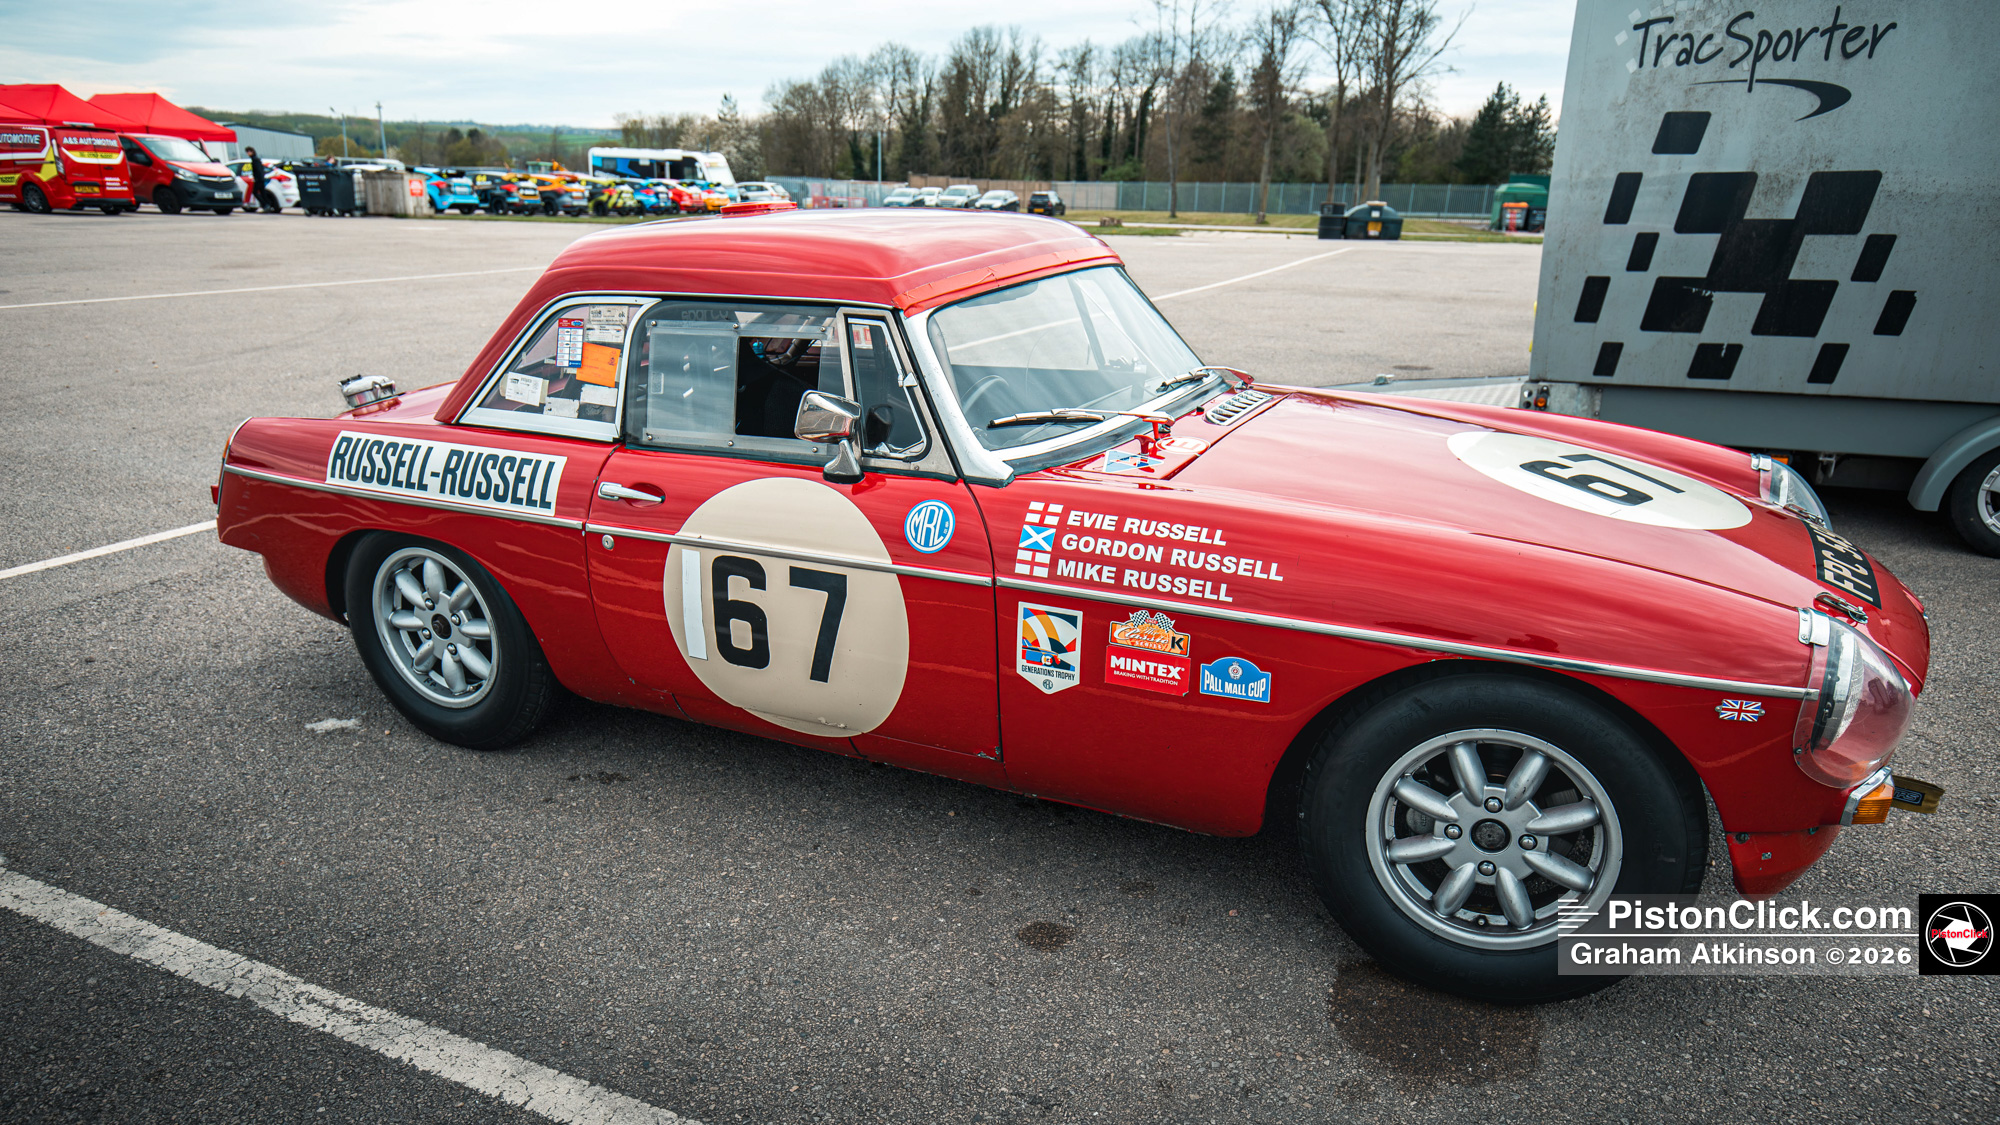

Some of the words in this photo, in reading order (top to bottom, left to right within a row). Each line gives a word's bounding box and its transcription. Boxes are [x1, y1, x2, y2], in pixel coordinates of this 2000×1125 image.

[1632, 5, 1898, 94] TracSporter
[79, 137, 119, 147] AUTOMOTIVE
[330, 436, 556, 510] RUSSELL-RUSSELL
[1518, 453, 1686, 507] 67
[910, 505, 945, 547] MRL
[1066, 510, 1119, 531] EVIE
[1122, 517, 1227, 547] RUSSELL
[1061, 533, 1164, 563] GORDON
[1170, 548, 1284, 582] RUSSELL
[1821, 549, 1874, 602] FPC
[1056, 558, 1117, 584] MIKE
[1122, 569, 1234, 603] RUSSELL
[711, 554, 848, 684] 67
[1113, 626, 1169, 644] Classic
[1134, 640, 1162, 649] SERIES
[1170, 636, 1185, 651] K
[1021, 664, 1055, 678] GENERATIONS
[1055, 670, 1076, 681] TROPHY
[1113, 670, 1136, 679] BRAKING
[1136, 674, 1150, 682] WITH
[1150, 676, 1179, 686] TRADITION
[1204, 669, 1223, 693] PALL
[1224, 682, 1246, 696] MALL
[1248, 677, 1267, 698] CUP
